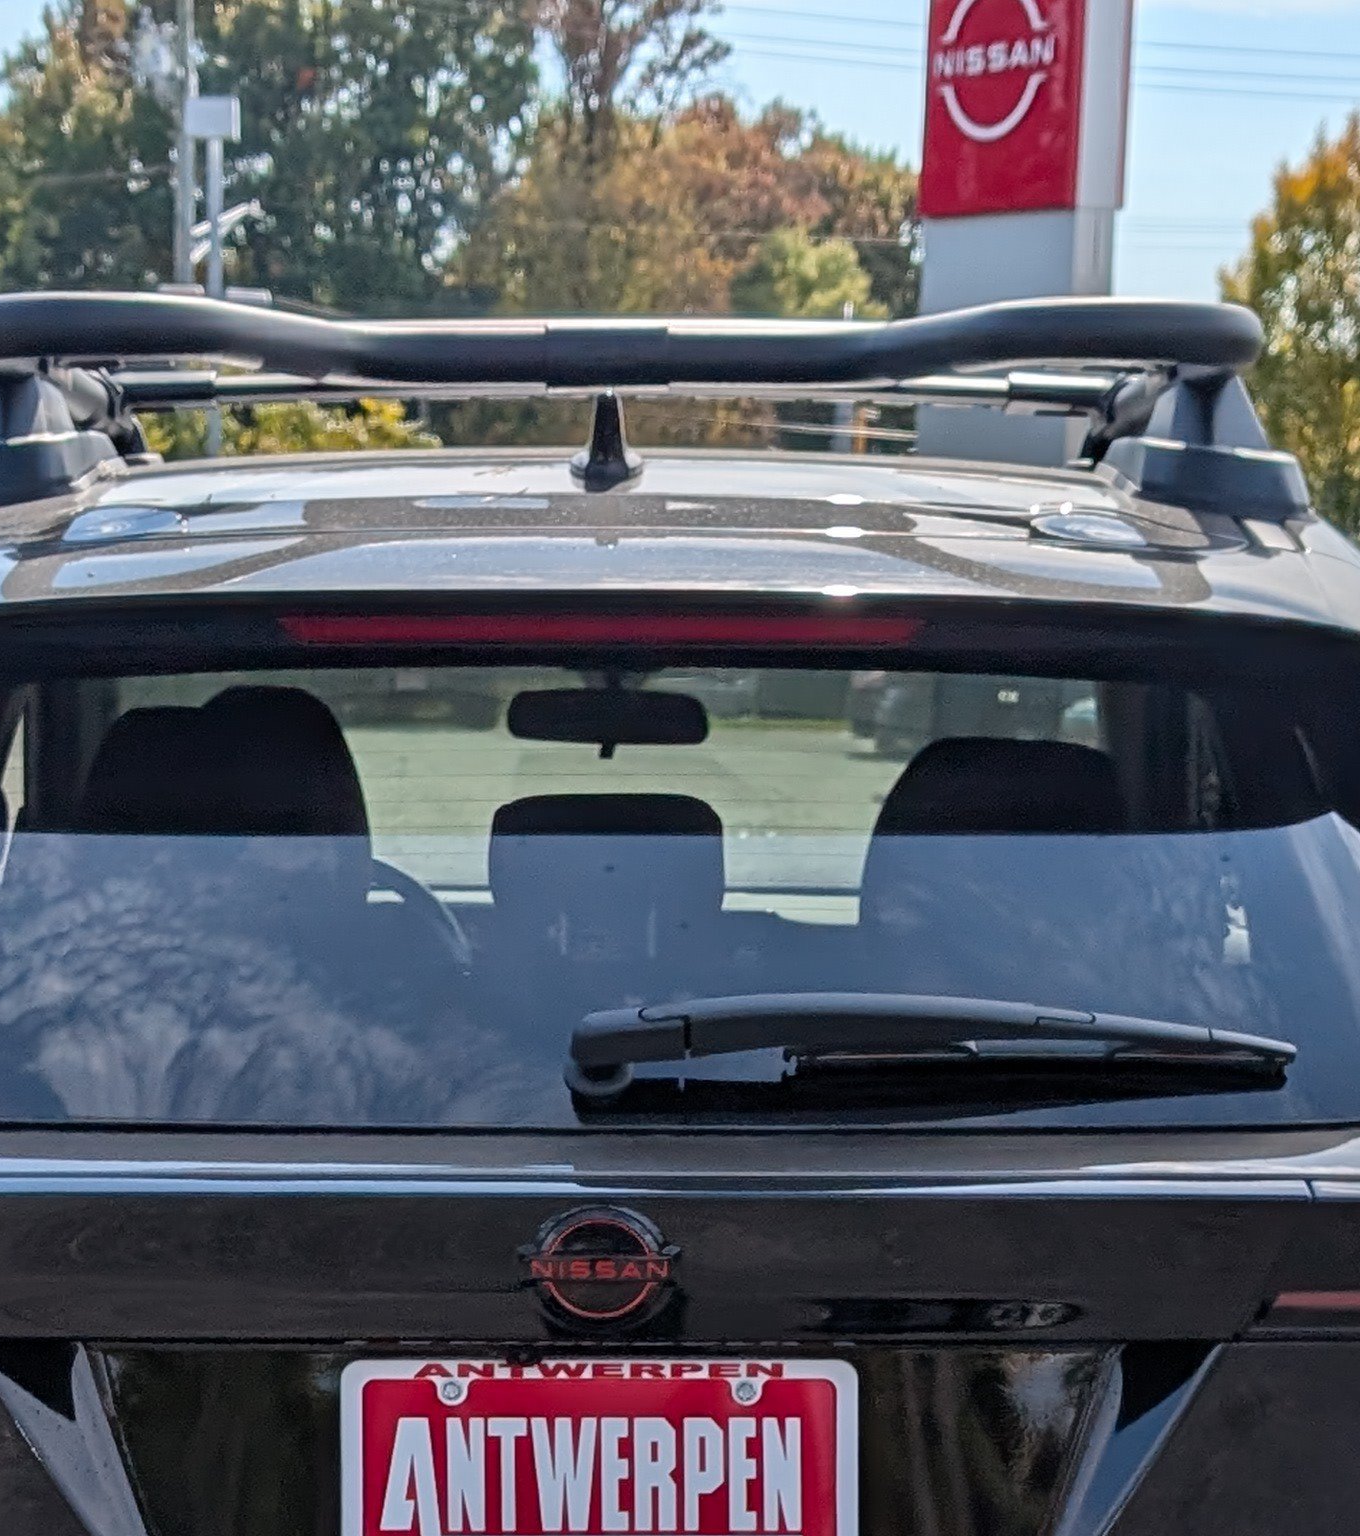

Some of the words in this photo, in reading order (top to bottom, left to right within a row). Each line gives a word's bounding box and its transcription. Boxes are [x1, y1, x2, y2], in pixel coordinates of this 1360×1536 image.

[933, 33, 1056, 78] NISSAN
[530, 1259, 670, 1279] NISSAN
[413, 1362, 785, 1379] ANTWERPEN
[379, 1416, 803, 1534] ANTWERPEN
